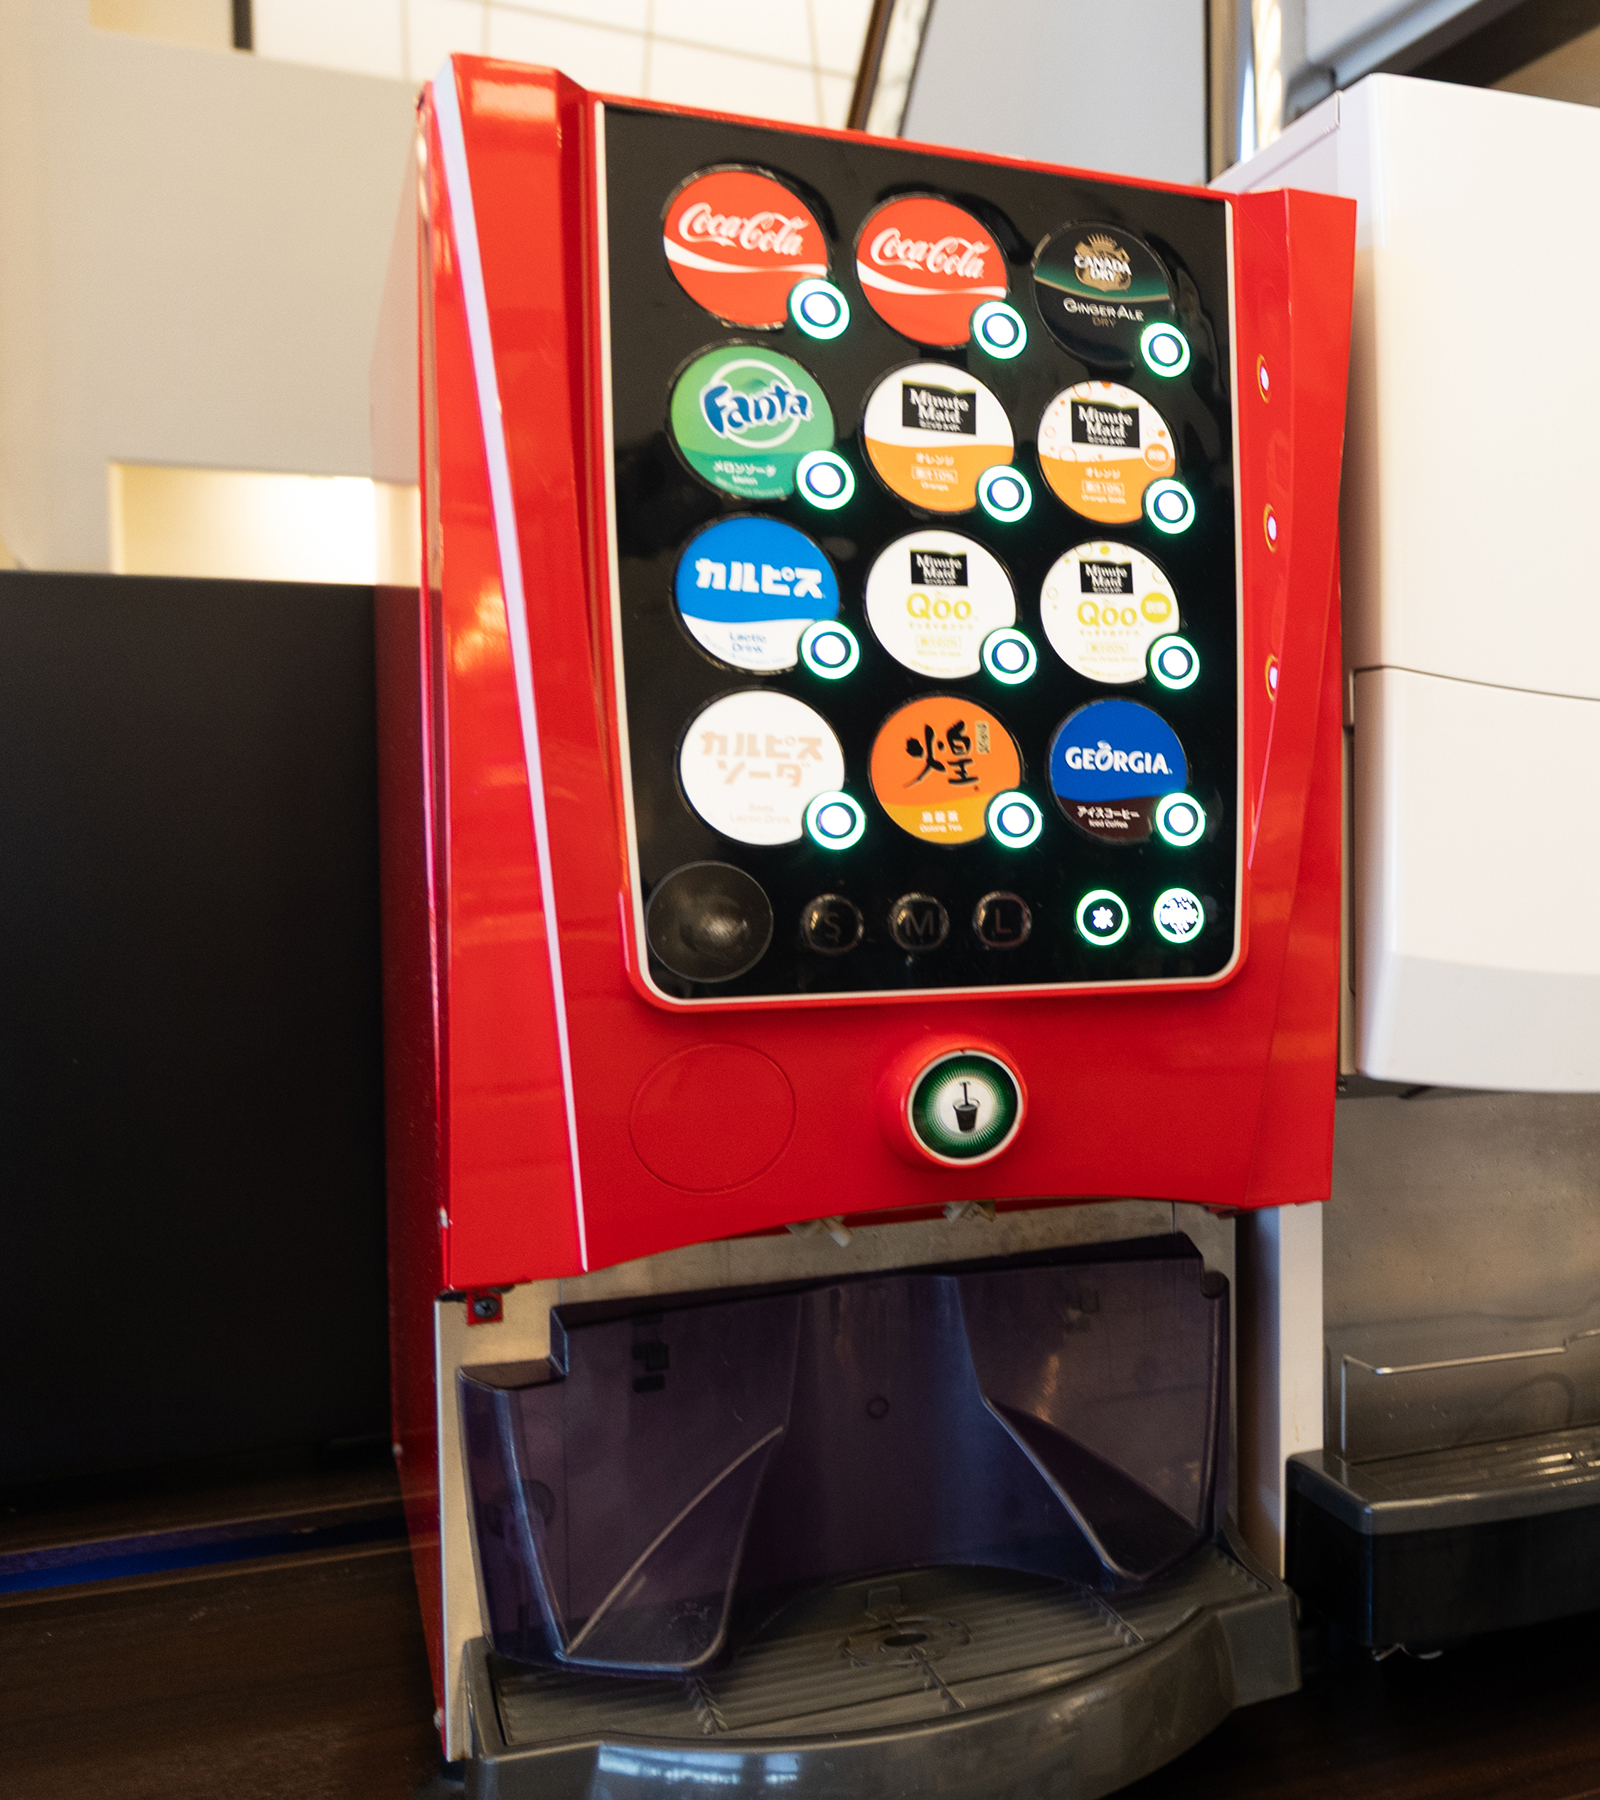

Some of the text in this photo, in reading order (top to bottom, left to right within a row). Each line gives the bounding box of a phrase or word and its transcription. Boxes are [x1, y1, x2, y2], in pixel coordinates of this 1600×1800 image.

[1073, 254, 1132, 276] CANADA
[1090, 267, 1116, 282] DRY
[701, 381, 813, 438] Fanta
[909, 387, 970, 412] Minute
[918, 404, 962, 425] Maid
[1077, 404, 1134, 427] Minute
[1086, 420, 1127, 439] Maid
[712, 459, 777, 478] メロンソーダ
[915, 553, 963, 570] Minute
[922, 565, 957, 580] Maid
[1084, 563, 1128, 579] Minute
[695, 557, 824, 600] カルピス
[906, 592, 972, 620] Qoo
[1077, 600, 1138, 627] Qoo
[701, 730, 823, 762] カルピス
[1065, 741, 1170, 775] GEORGIA
[716, 759, 811, 788] ソーダ
[1076, 805, 1141, 821] アイスコーヒー
[823, 912, 842, 942] S
[905, 909, 935, 937] M
[994, 907, 1013, 935] L
